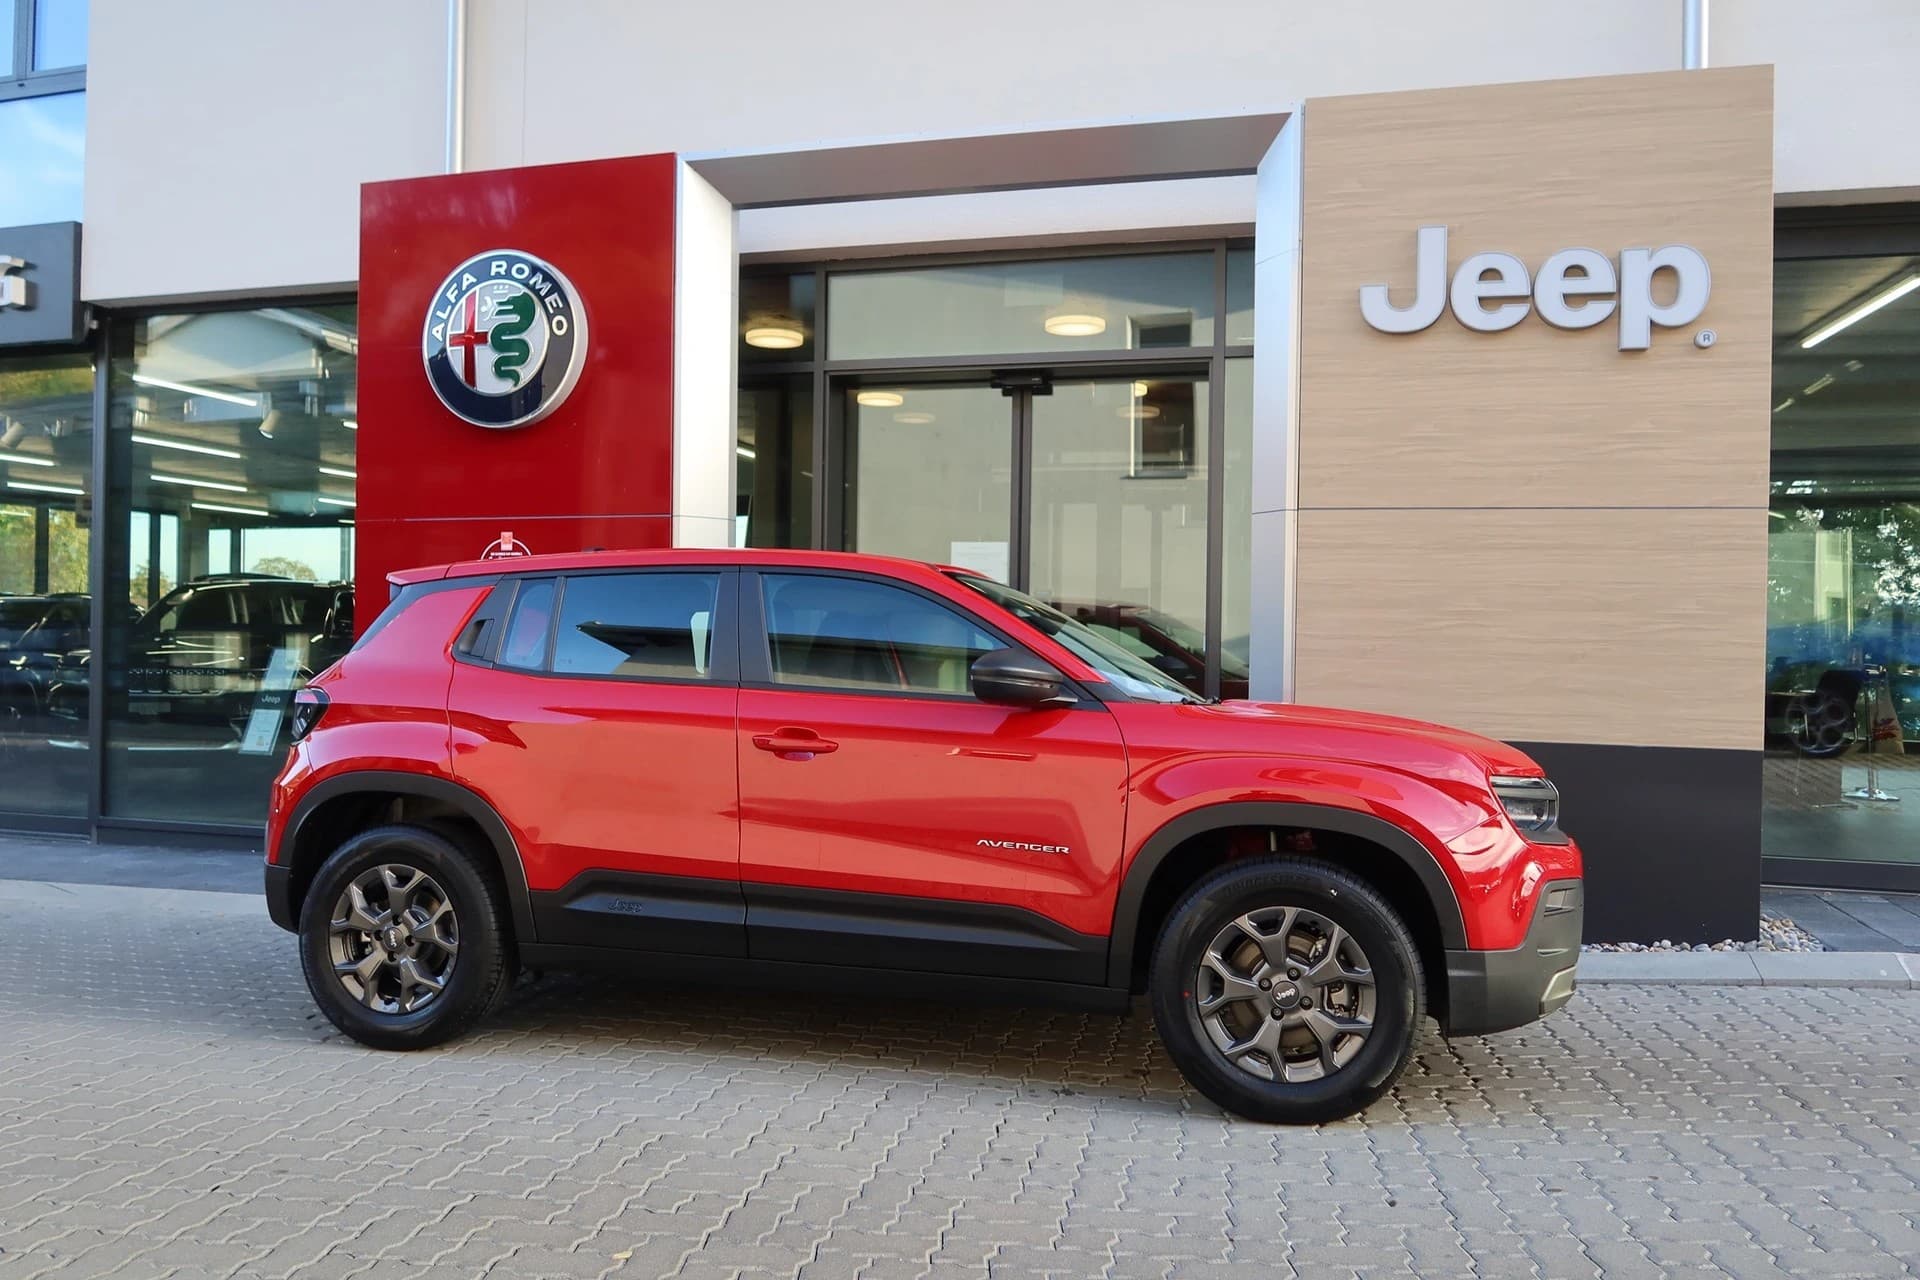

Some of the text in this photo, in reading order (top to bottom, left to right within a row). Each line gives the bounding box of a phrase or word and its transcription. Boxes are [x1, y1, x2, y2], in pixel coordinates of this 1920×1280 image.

[431, 260, 568, 342] ALFA ROMEO
[1360, 224, 1712, 351] Jeep
[976, 839, 1070, 854] AVENGER
[1275, 987, 1296, 1001] Jeep
